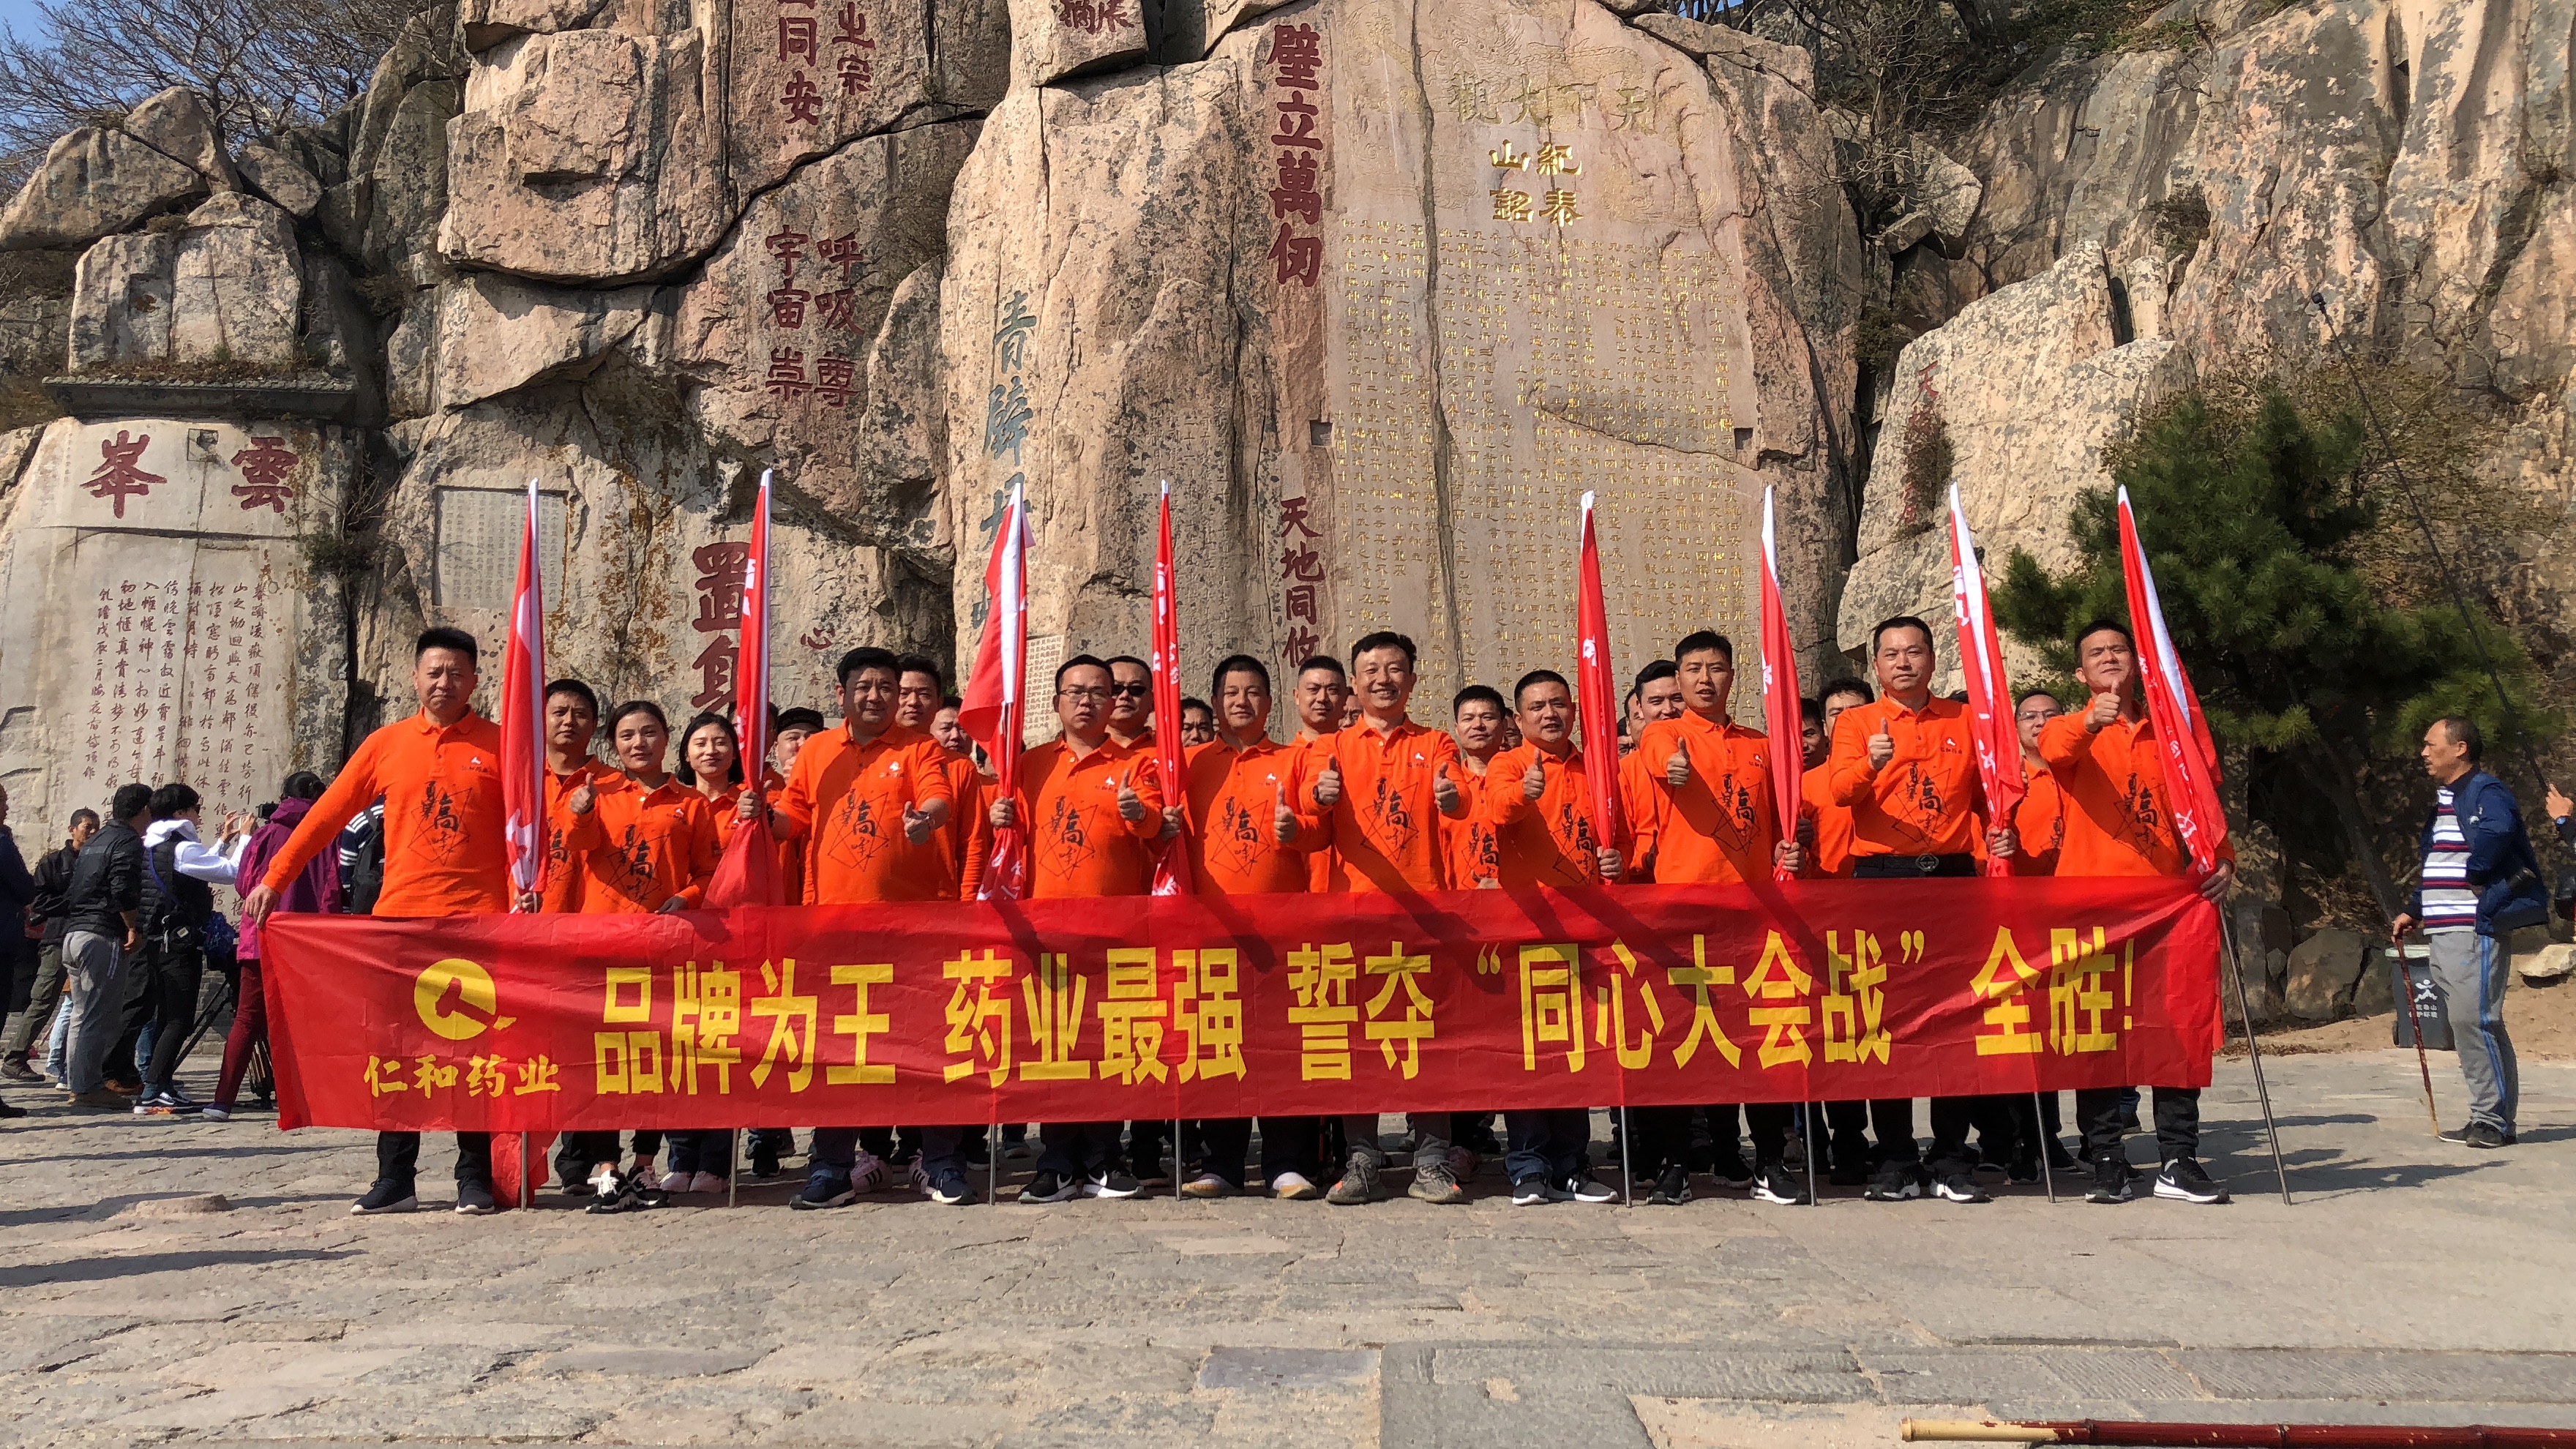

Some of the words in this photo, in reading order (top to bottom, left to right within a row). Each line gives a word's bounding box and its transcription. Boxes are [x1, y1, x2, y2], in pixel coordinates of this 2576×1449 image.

[596, 960, 894, 1093] 品牌为王
[944, 949, 1246, 1087] 药业最强
[1289, 943, 1434, 1079] 誓夺
[365, 1056, 559, 1096] 仁和药业
